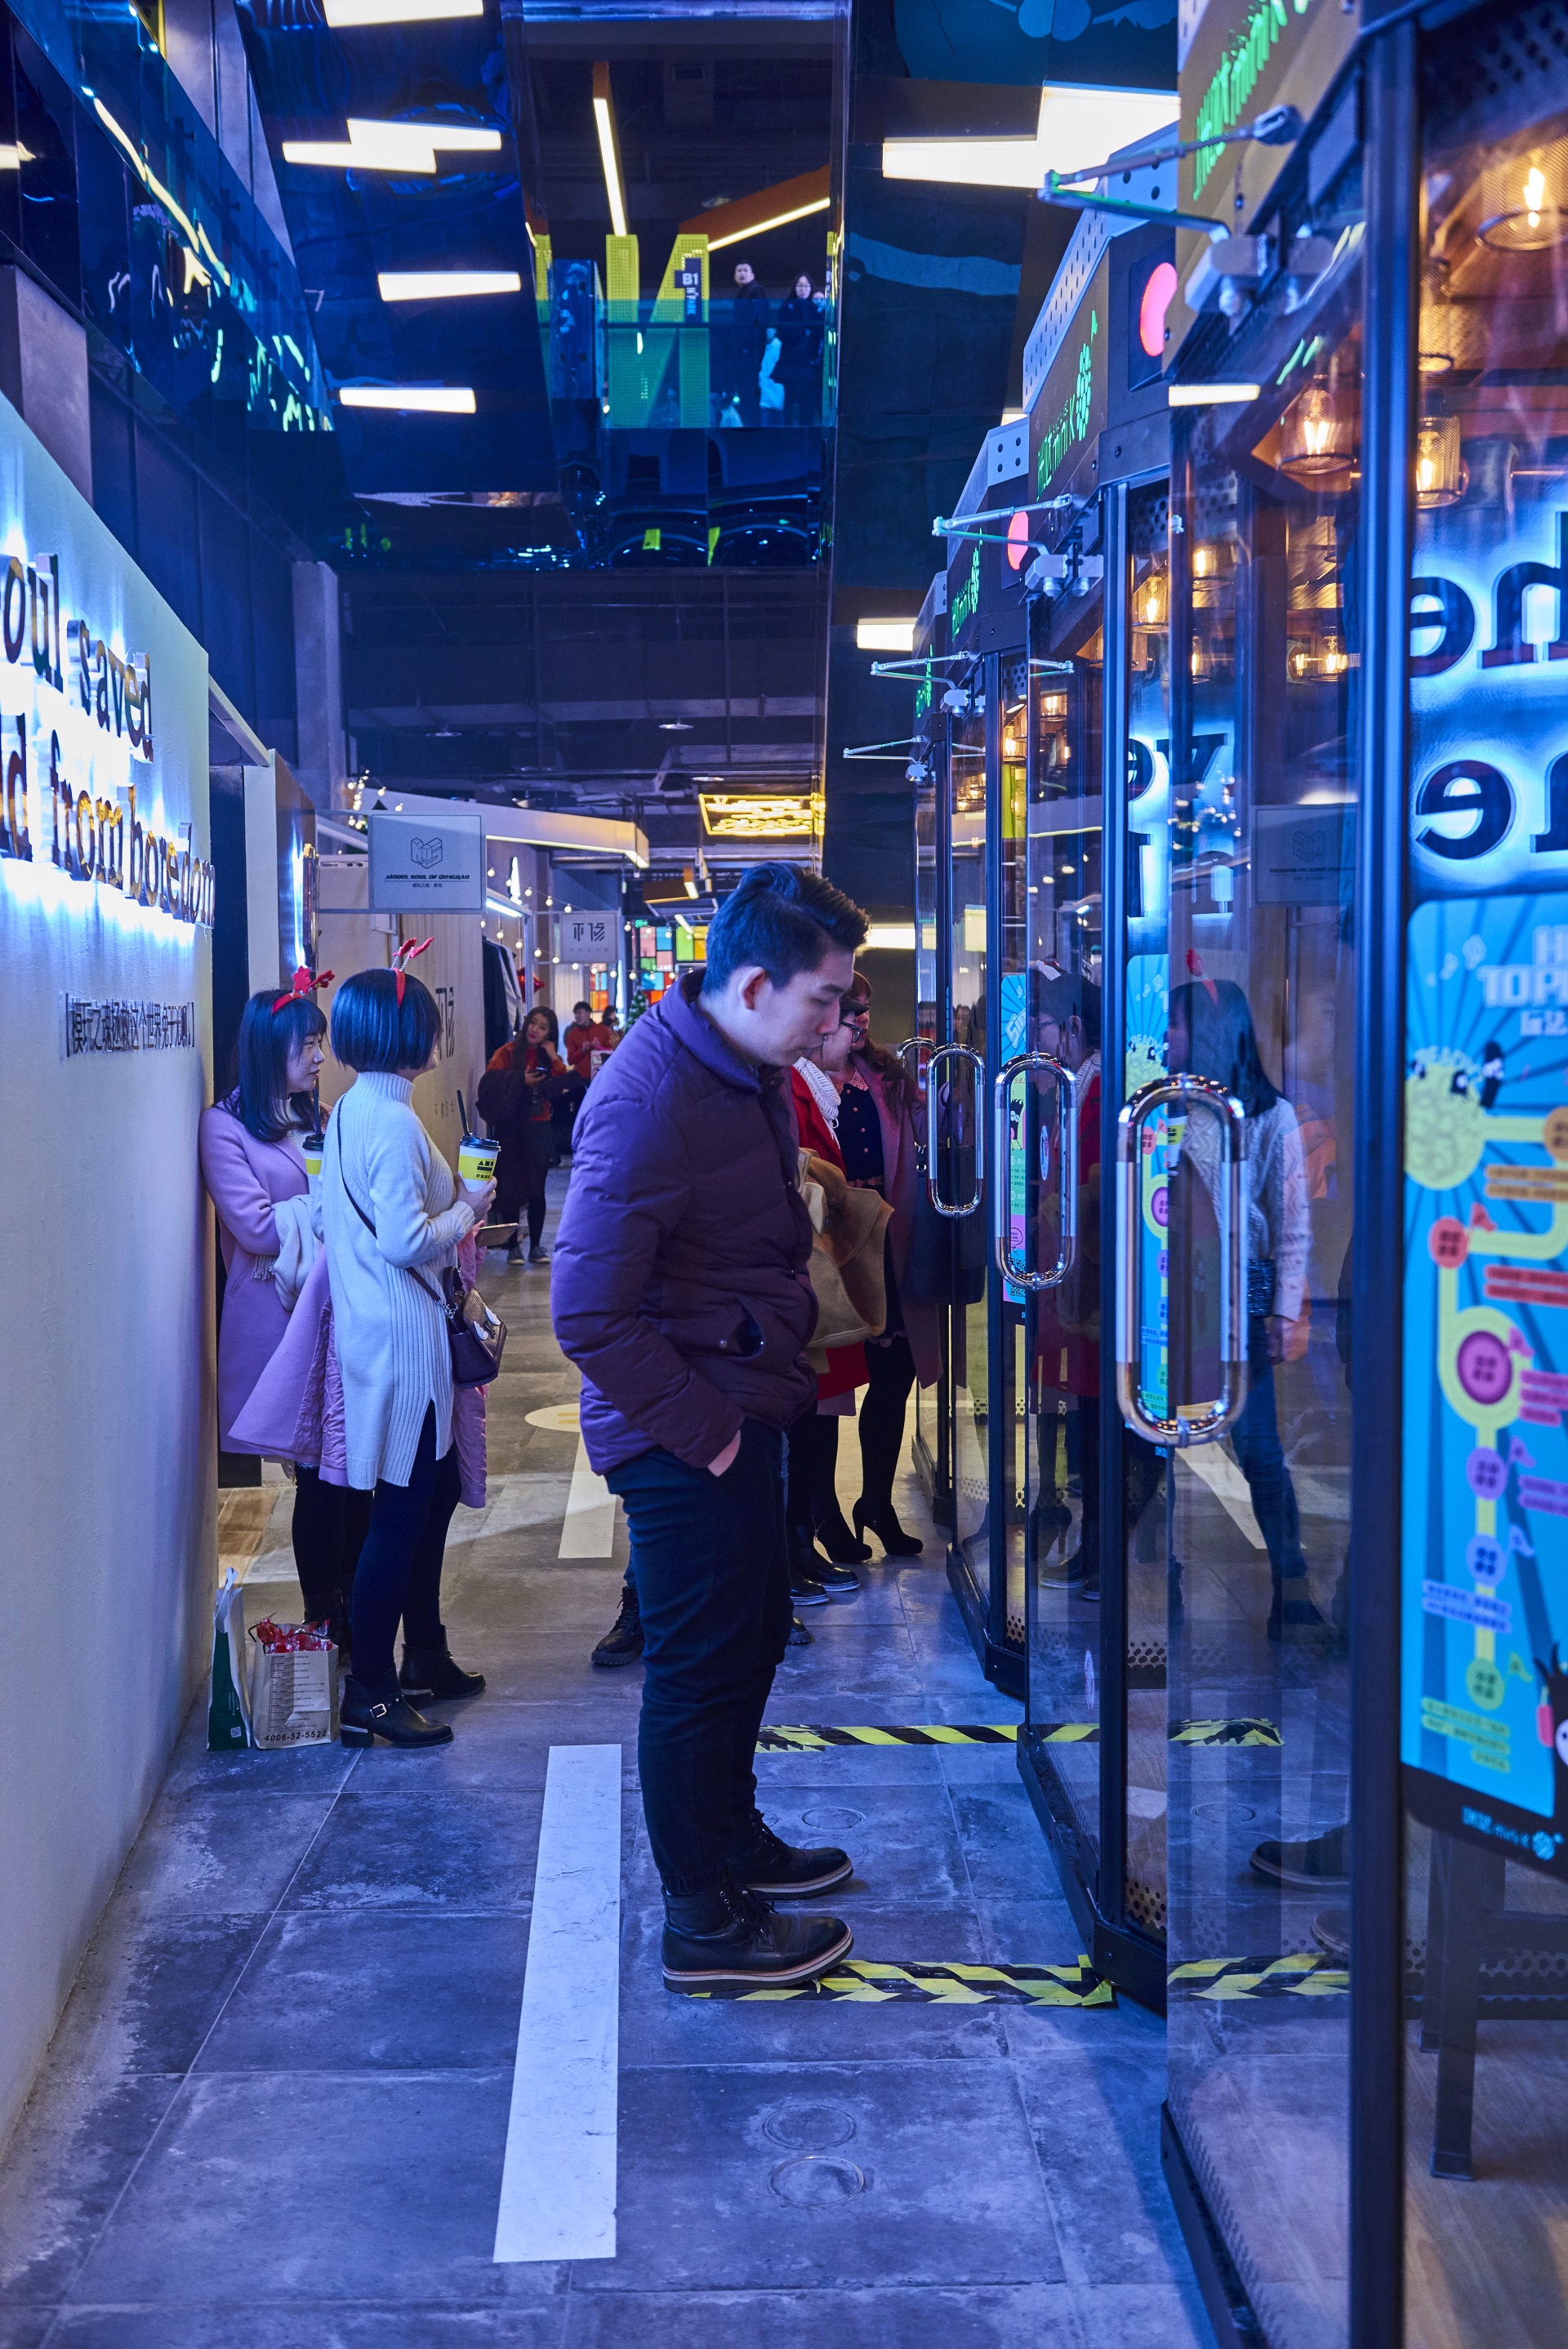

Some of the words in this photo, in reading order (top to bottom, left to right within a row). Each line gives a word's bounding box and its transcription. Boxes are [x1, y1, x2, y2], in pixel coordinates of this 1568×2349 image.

[682, 272, 698, 285] B1
[76, 620, 154, 763] saved
[51, 729, 124, 884] from
[127, 785, 216, 928] boredom
[265, 1729, 327, 1742] 4006-52-5522
